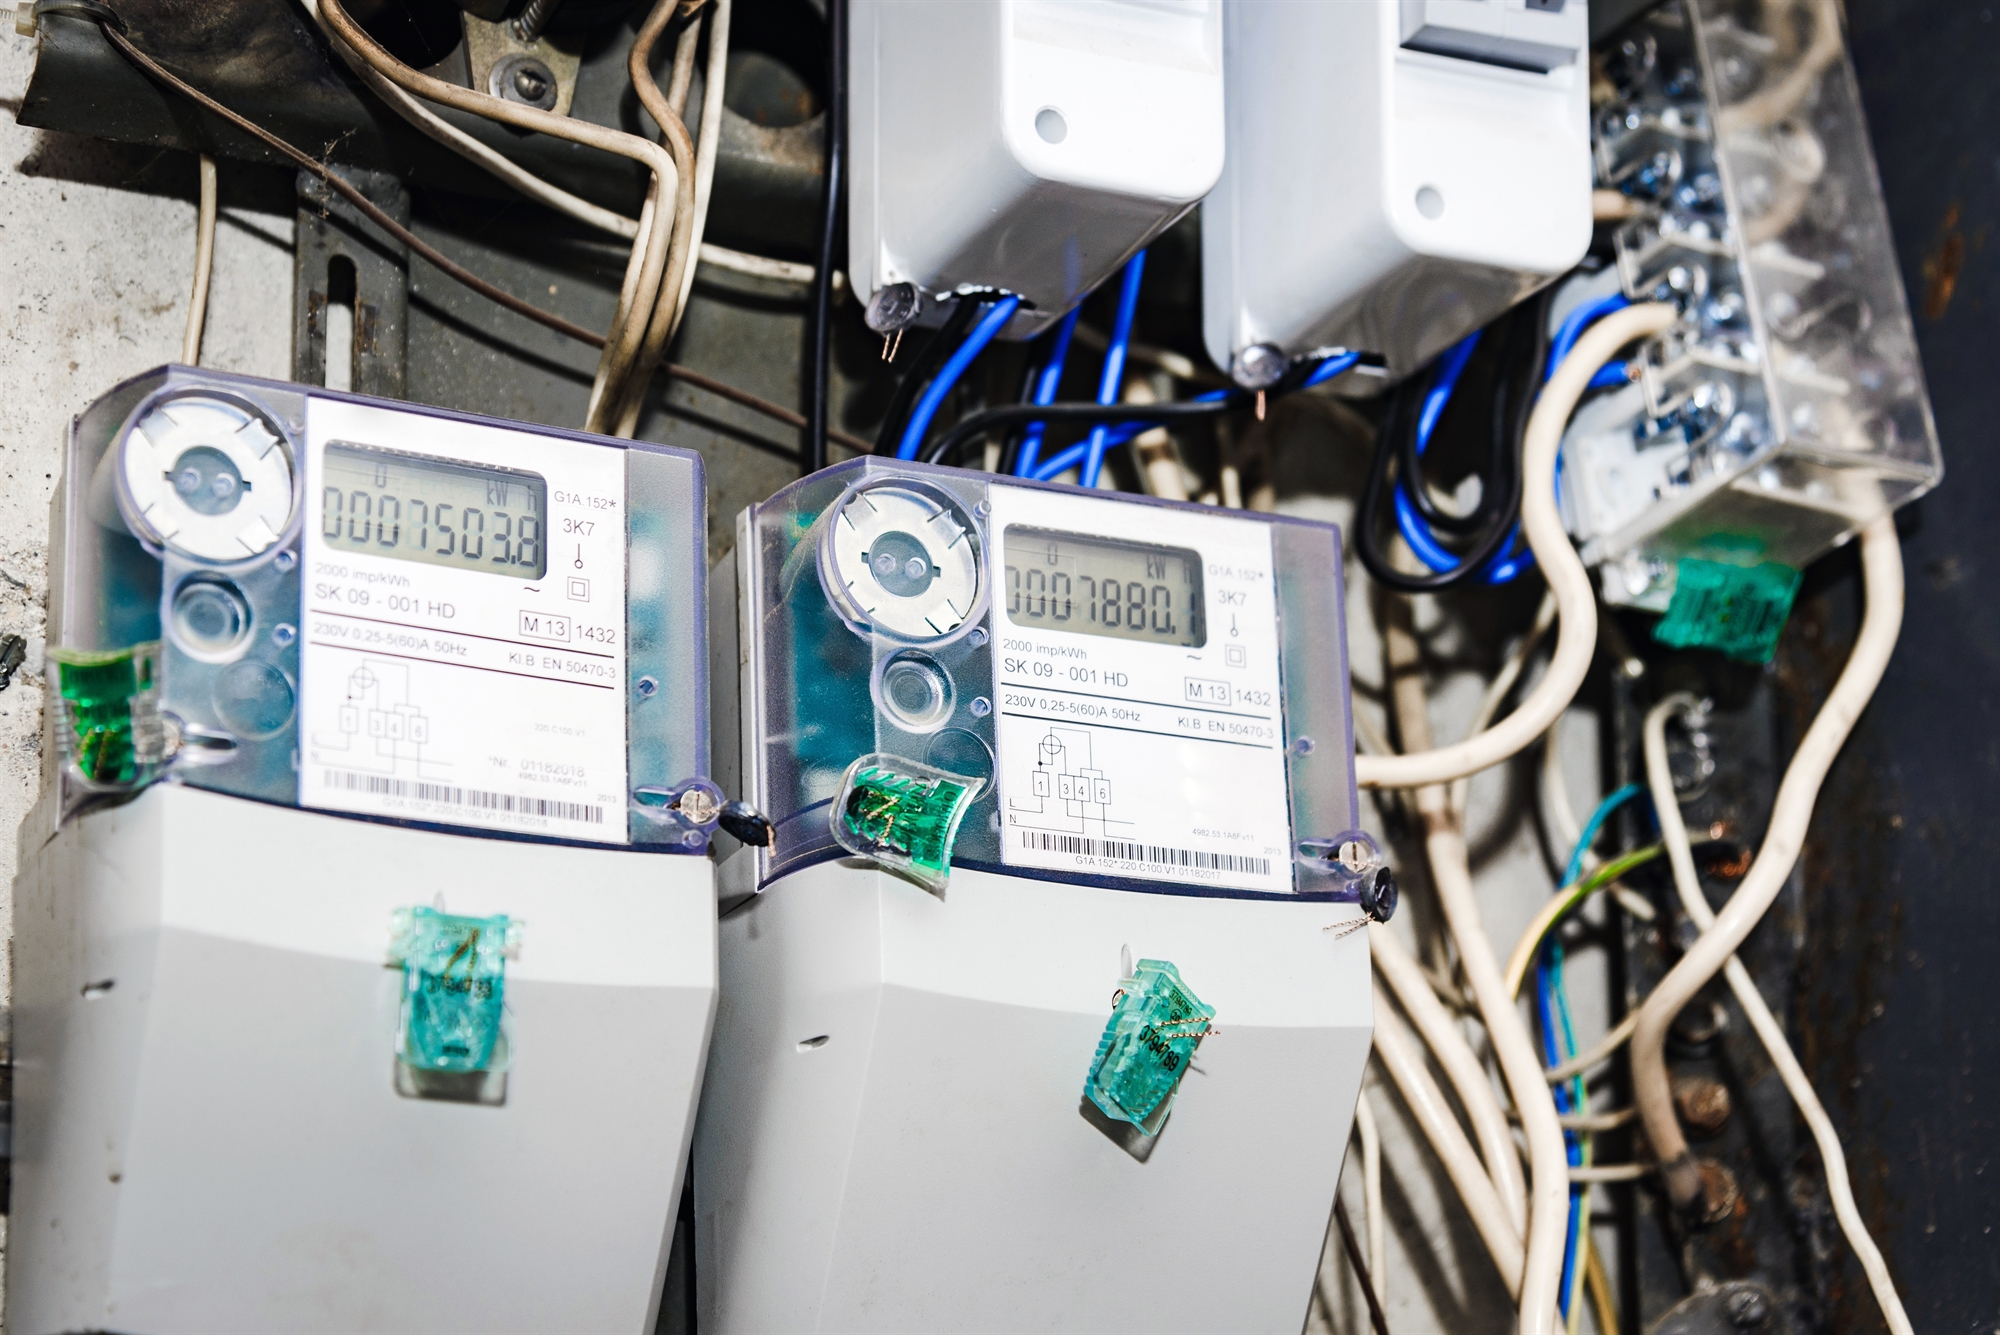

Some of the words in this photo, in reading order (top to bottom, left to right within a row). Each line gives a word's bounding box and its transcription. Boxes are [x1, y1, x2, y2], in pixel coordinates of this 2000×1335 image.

[323, 486, 539, 568] 0007503.8
[562, 517, 596, 537] 3K7
[315, 562, 349, 580] 2000
[352, 566, 411, 589] imp/kWh
[315, 583, 344, 603] SK
[349, 587, 371, 606] 09
[388, 594, 420, 615] 001
[428, 601, 456, 619] HD
[1217, 590, 1247, 607] 3K7
[313, 621, 349, 639] 230V
[434, 640, 468, 657] 50Hz
[523, 616, 538, 633] M
[544, 619, 565, 637] 13
[576, 624, 616, 645] 1432
[1003, 638, 1033, 653] 2000
[1036, 643, 1088, 660] imp/kWh
[543, 657, 562, 671] EN
[565, 659, 616, 679] 50470-3
[1004, 658, 1028, 675] SK
[1033, 661, 1053, 678] 09
[1069, 667, 1097, 684] 001
[1104, 672, 1129, 688] HD
[1189, 683, 1203, 698] M
[1208, 685, 1227, 701] 13
[1235, 689, 1272, 707] 1432
[1005, 693, 1036, 708] 230V
[1111, 708, 1141, 723] 50Hz
[346, 715, 351, 728] 1
[373, 719, 381, 732] 3
[390, 721, 398, 733] 4
[414, 725, 422, 737] 6
[1208, 721, 1225, 734] EN
[1228, 722, 1274, 739] 50470-3
[520, 758, 586, 779] 01182018
[597, 793, 617, 804] 2013
[1037, 780, 1043, 792] 1
[1063, 784, 1070, 795] 3
[1078, 786, 1085, 797] 4
[1099, 788, 1106, 799] 6
[1009, 798, 1016, 808] L
[1009, 814, 1017, 824] N
[1263, 847, 1283, 857] 2013
[1178, 867, 1221, 881] 01182017
[1139, 1025, 1180, 1072] 3794789
